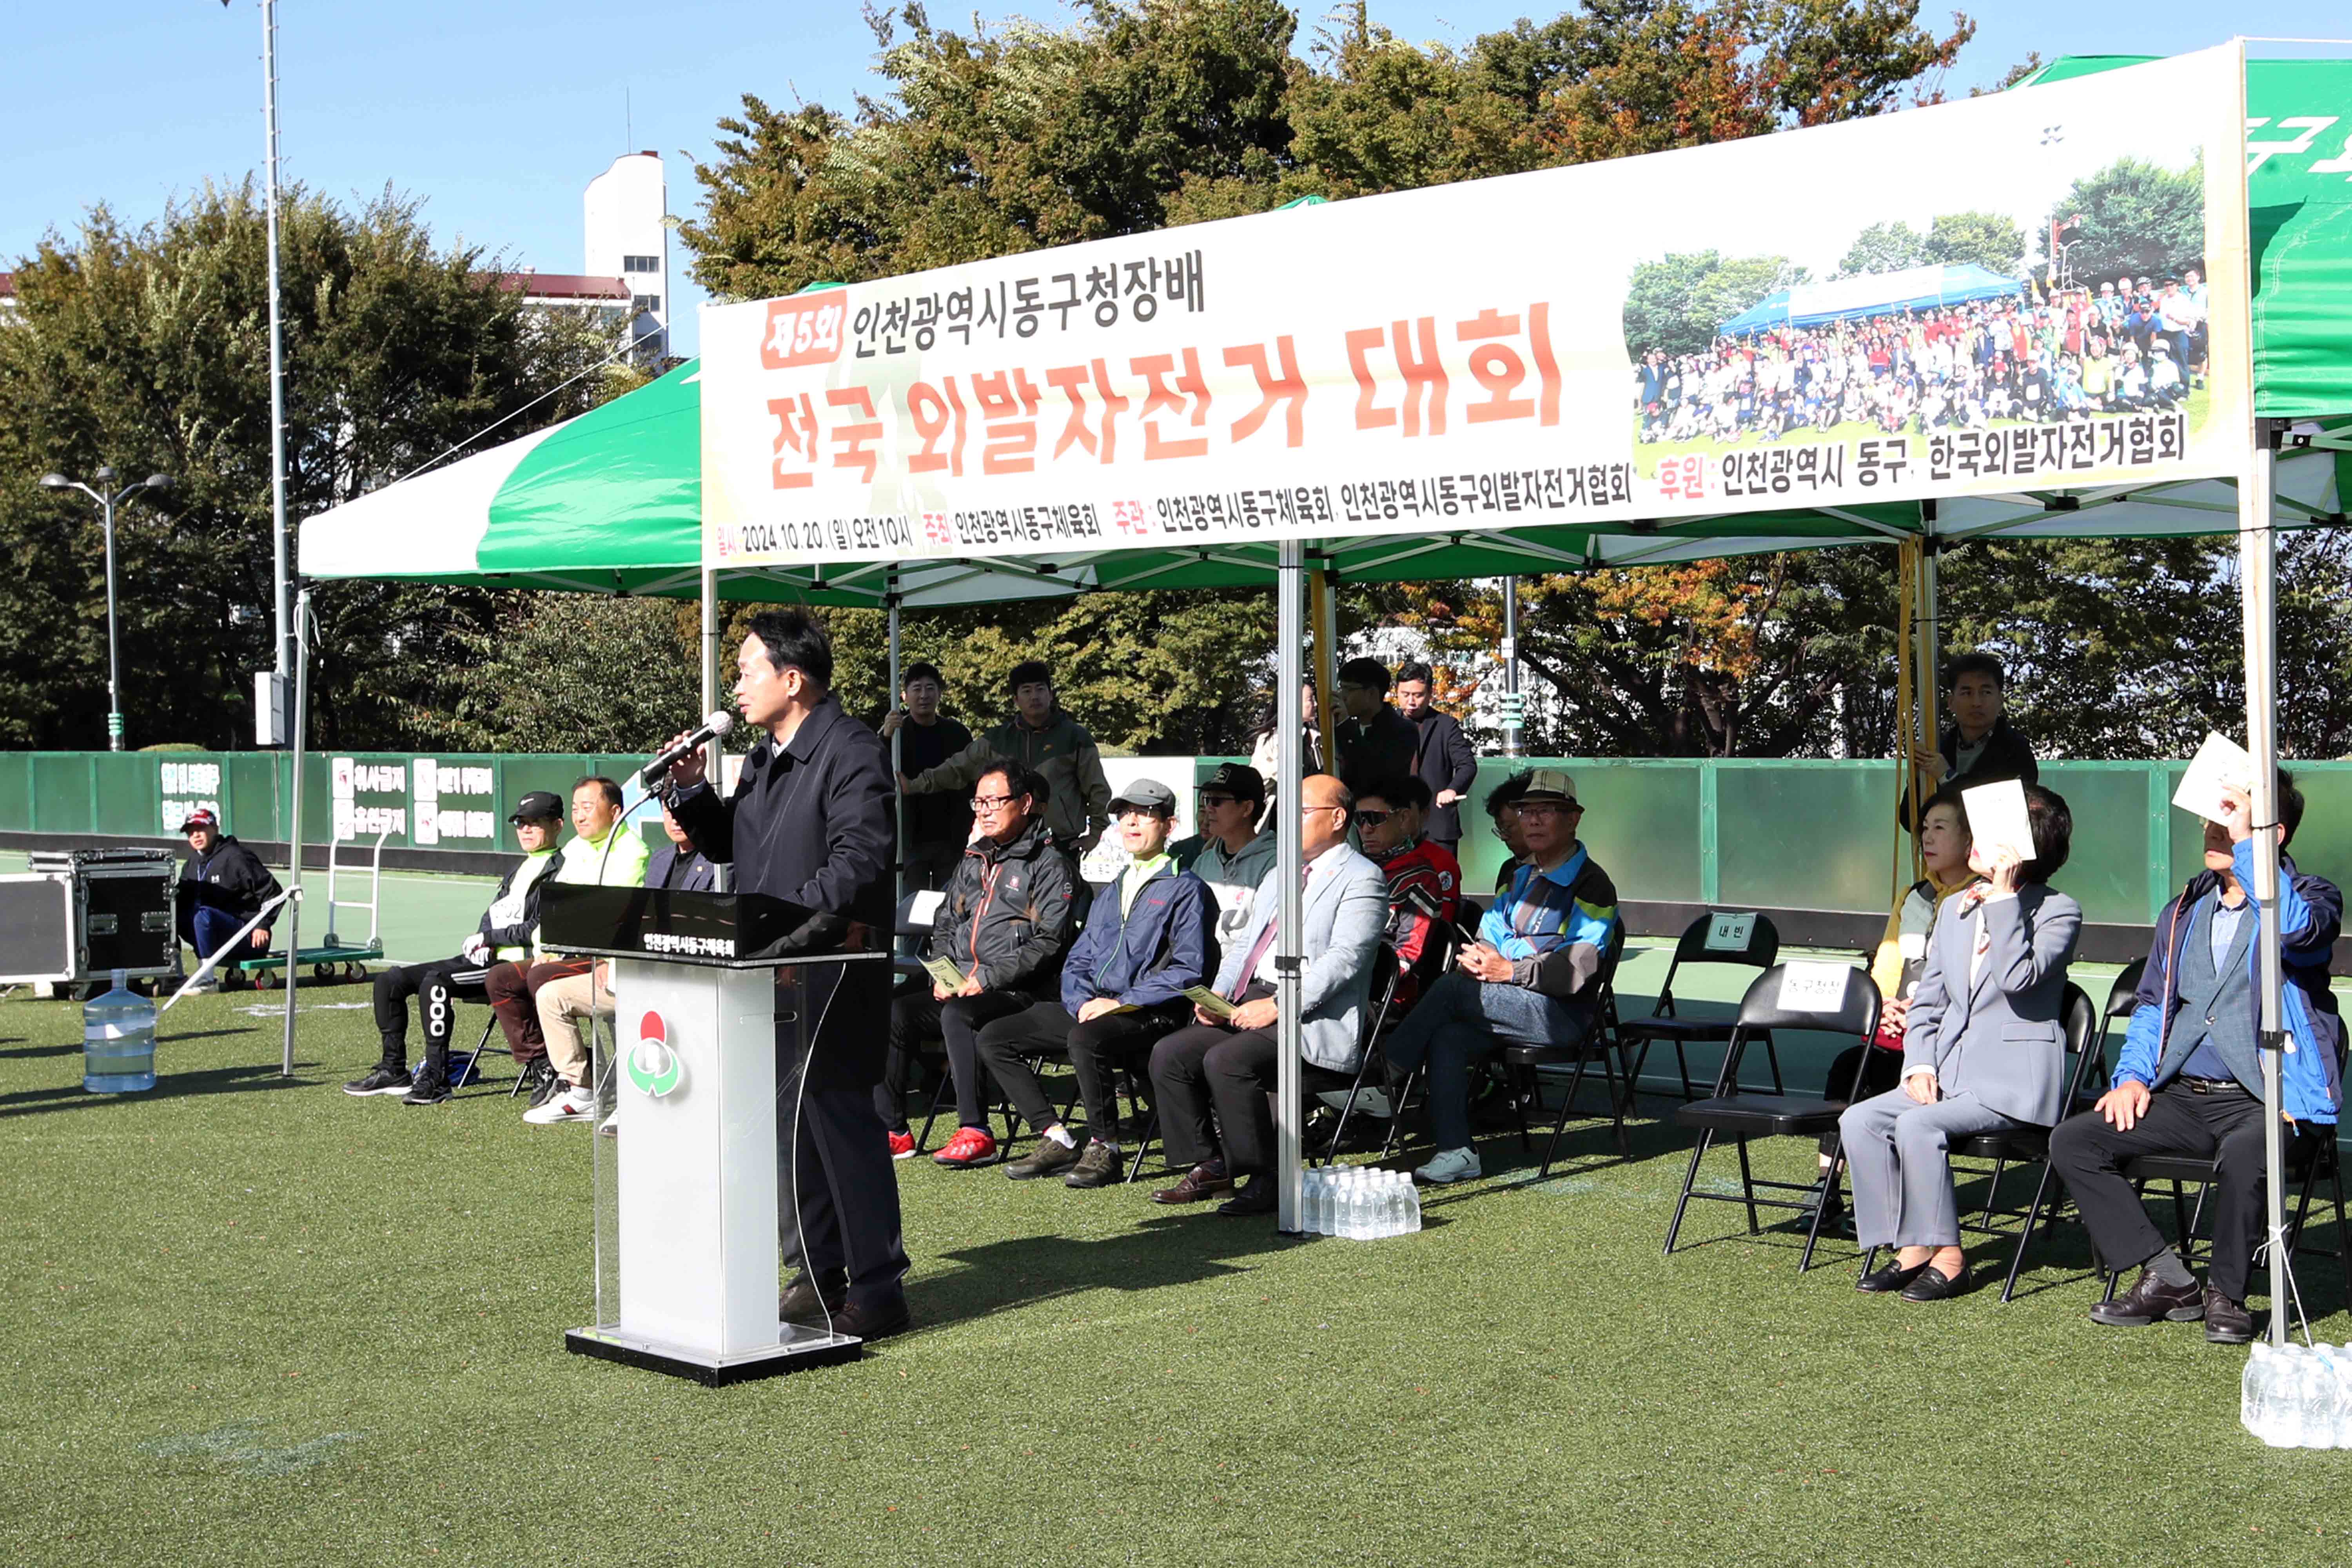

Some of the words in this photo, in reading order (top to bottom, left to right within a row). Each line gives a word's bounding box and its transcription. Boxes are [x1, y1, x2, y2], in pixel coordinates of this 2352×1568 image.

[766, 304, 842, 359] 제5회
[854, 250, 1204, 359] 인천광역시동구청장배
[767, 386, 884, 490] 전국
[907, 335, 1309, 477] 외발자전거
[1345, 301, 1563, 438] 대회
[1341, 463, 1632, 521] 인천광역시동구외발자전거협회
[1722, 445, 1844, 496] 인천광역시
[1929, 414, 2184, 480] 한국외발자전거협회
[955, 503, 1102, 544] 인천광역시동구체육회
